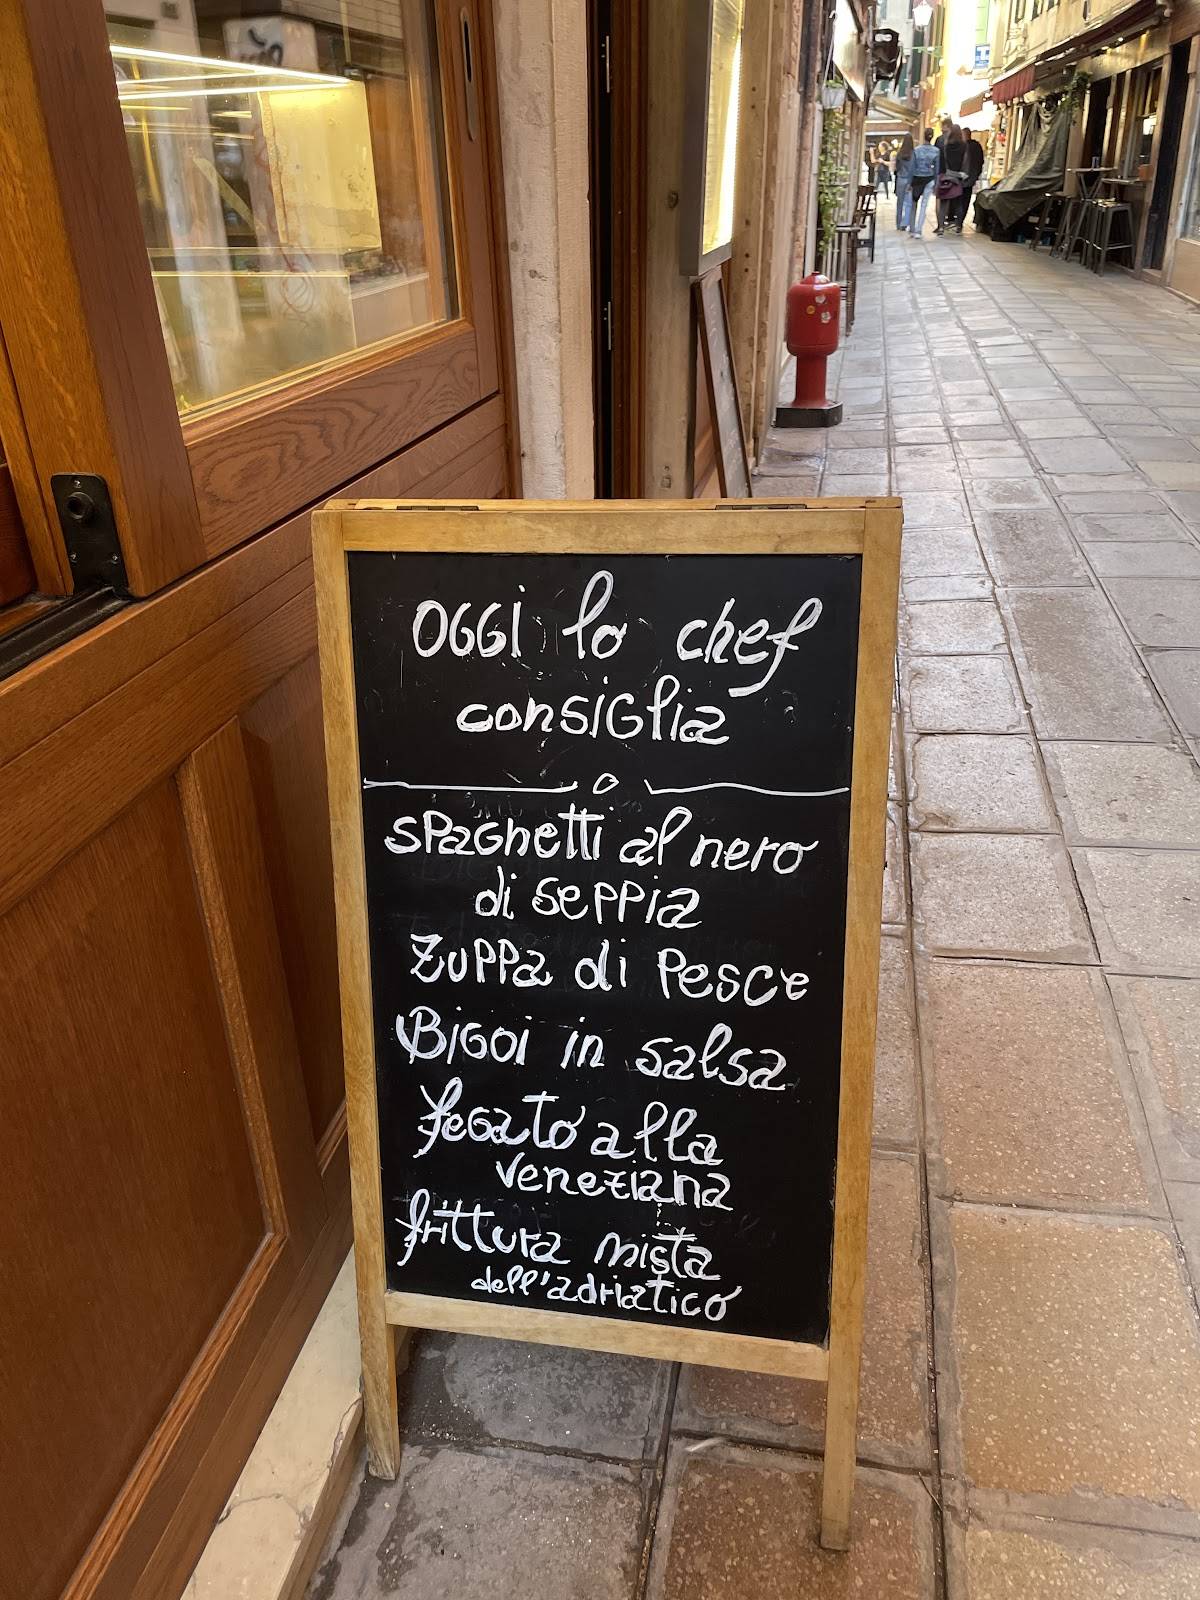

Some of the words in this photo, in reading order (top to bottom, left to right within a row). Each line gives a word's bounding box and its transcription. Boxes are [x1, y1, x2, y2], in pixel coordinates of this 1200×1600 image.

[562, 569, 628, 660] lo
[676, 597, 823, 698] chef
[618, 805, 693, 868] al
[690, 833, 820, 875] nero
[474, 865, 517, 920] di
[574, 937, 628, 992] di
[559, 1015, 605, 1070] in
[634, 1022, 788, 1092] salsa
[590, 1100, 725, 1166] alla
[394, 1188, 572, 1267] frittura
